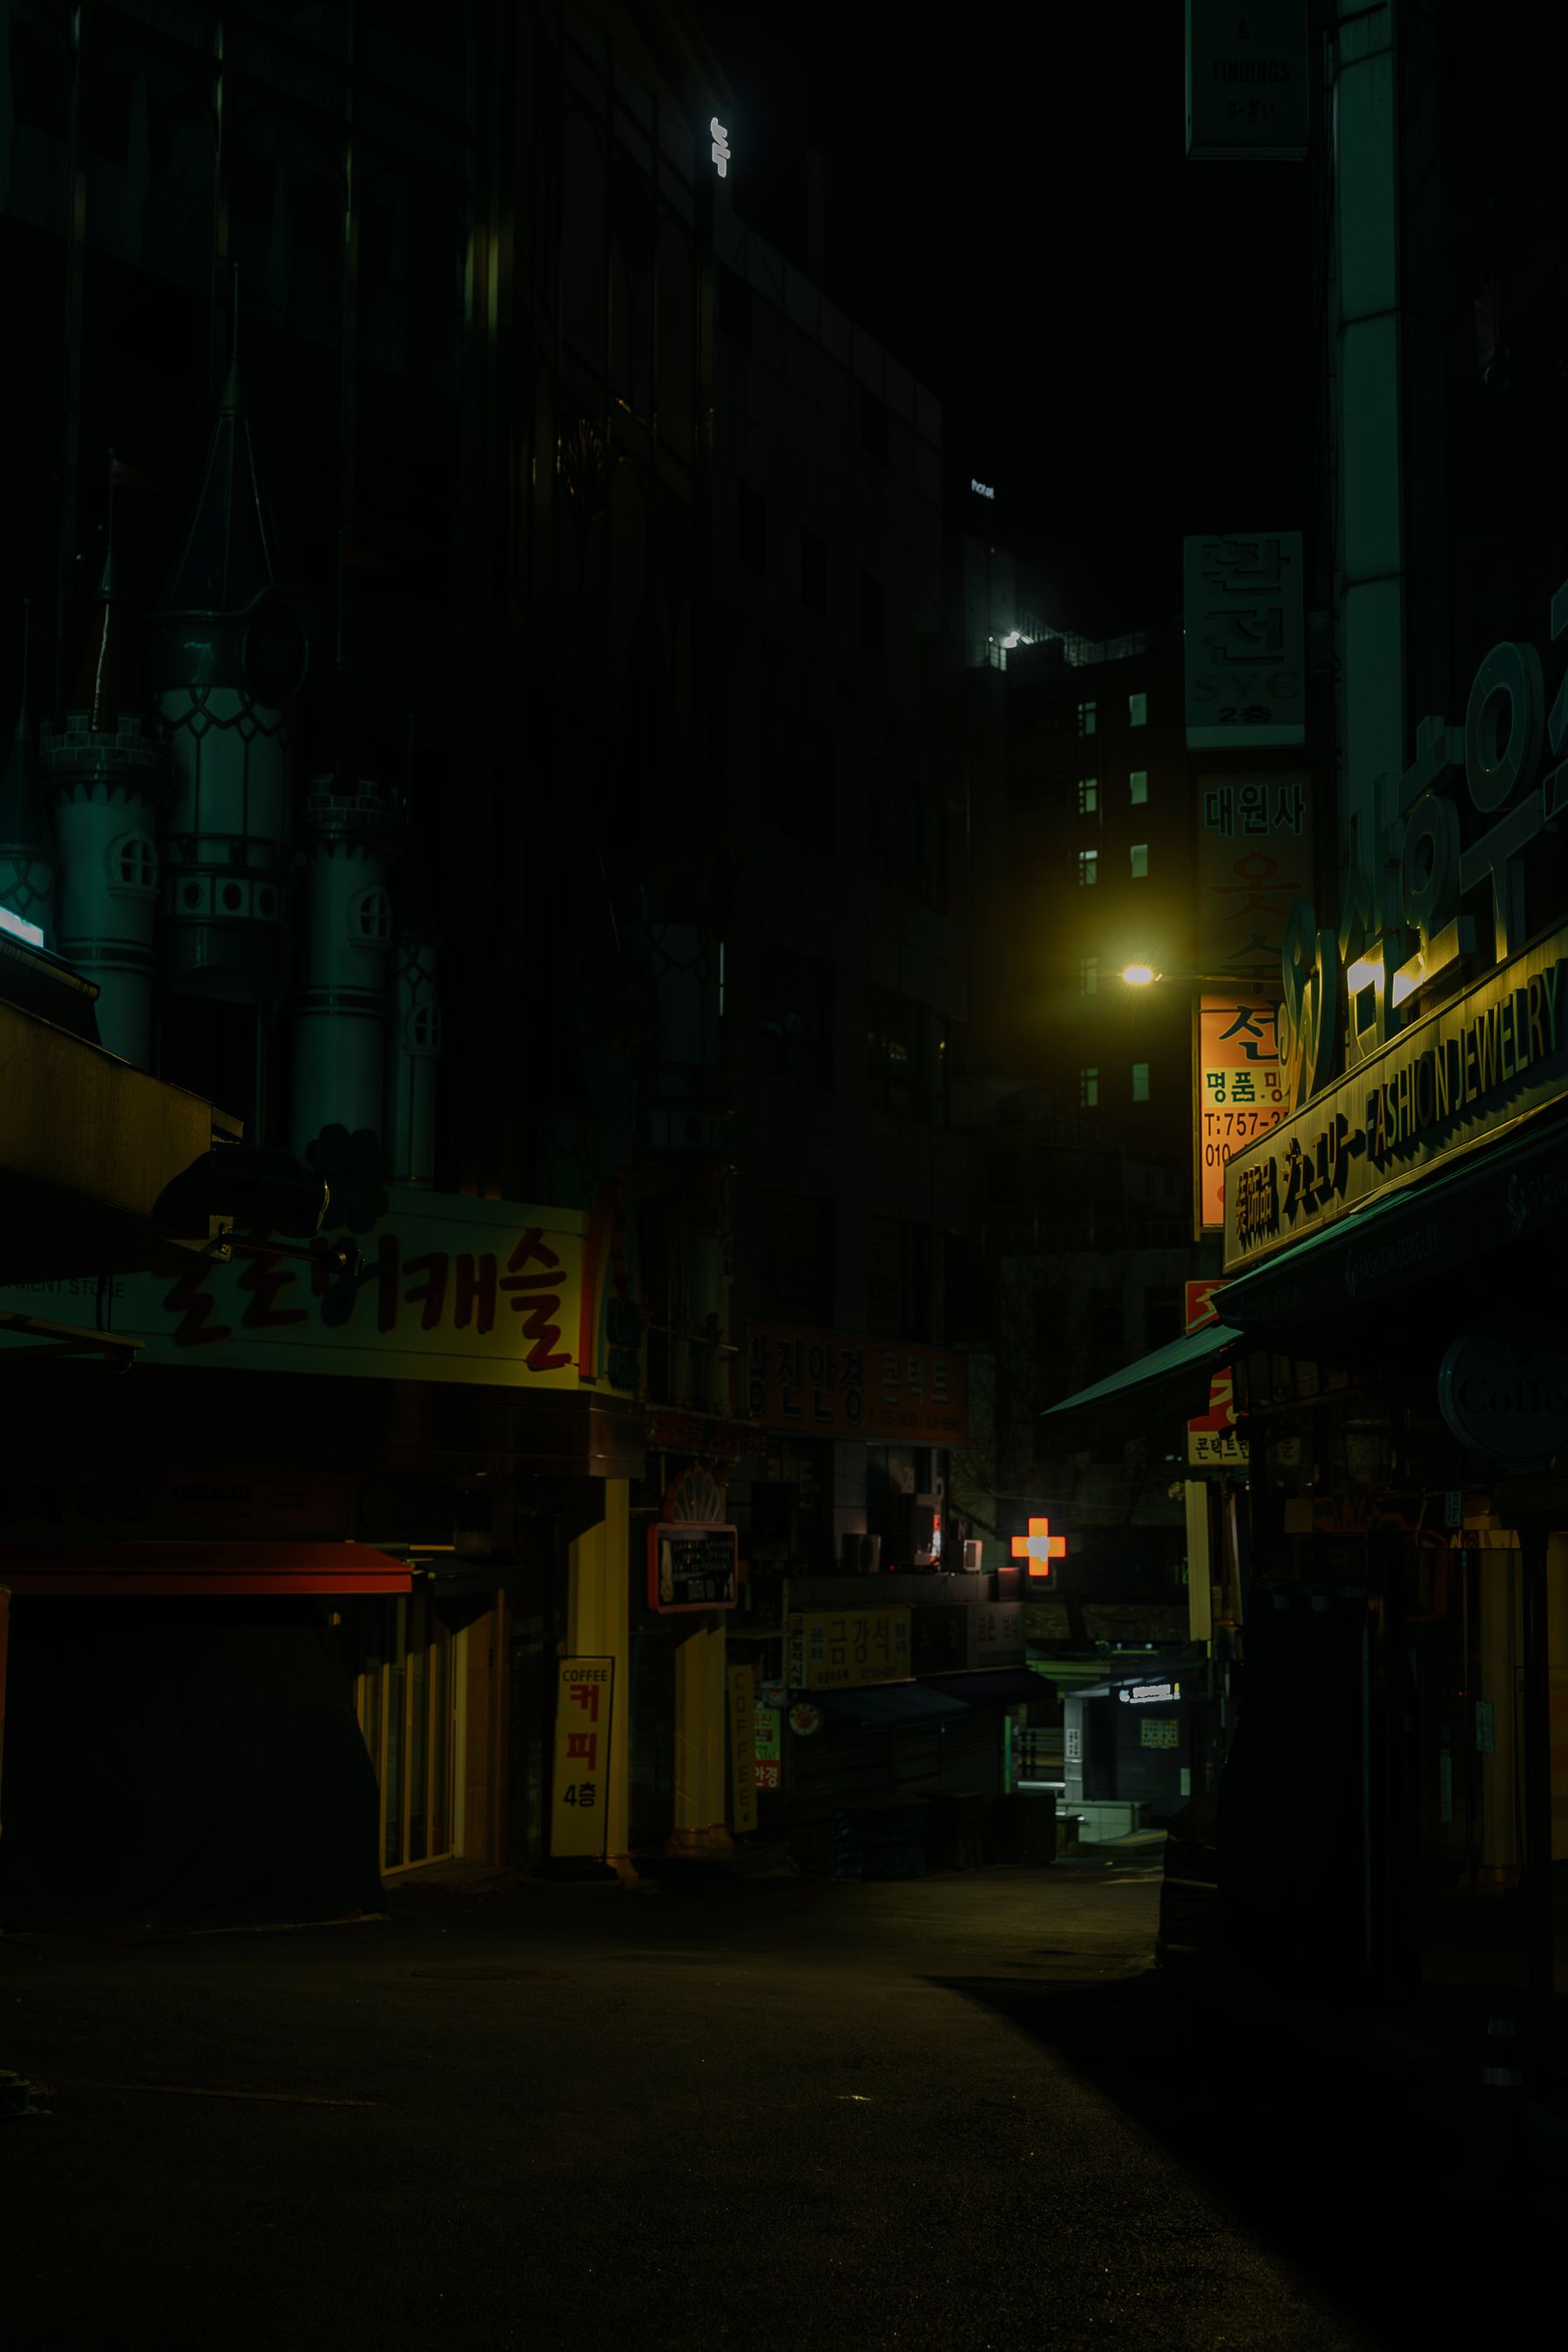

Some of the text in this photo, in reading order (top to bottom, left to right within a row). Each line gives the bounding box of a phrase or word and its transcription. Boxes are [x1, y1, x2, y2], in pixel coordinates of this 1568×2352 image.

[1238, 17, 1250, 41] &
[1212, 59, 1289, 84] FINDINGS
[1216, 706, 1273, 726] 2층
[1203, 783, 1305, 836] 대원사
[1365, 1045, 1450, 1159] FASHION
[1455, 959, 1565, 1112] JEWELRY
[1458, 1378, 1568, 1414] Coffe
[562, 1669, 606, 1683] COFFEE
[565, 1685, 598, 1771] 커피
[563, 1782, 596, 1808] 4층
